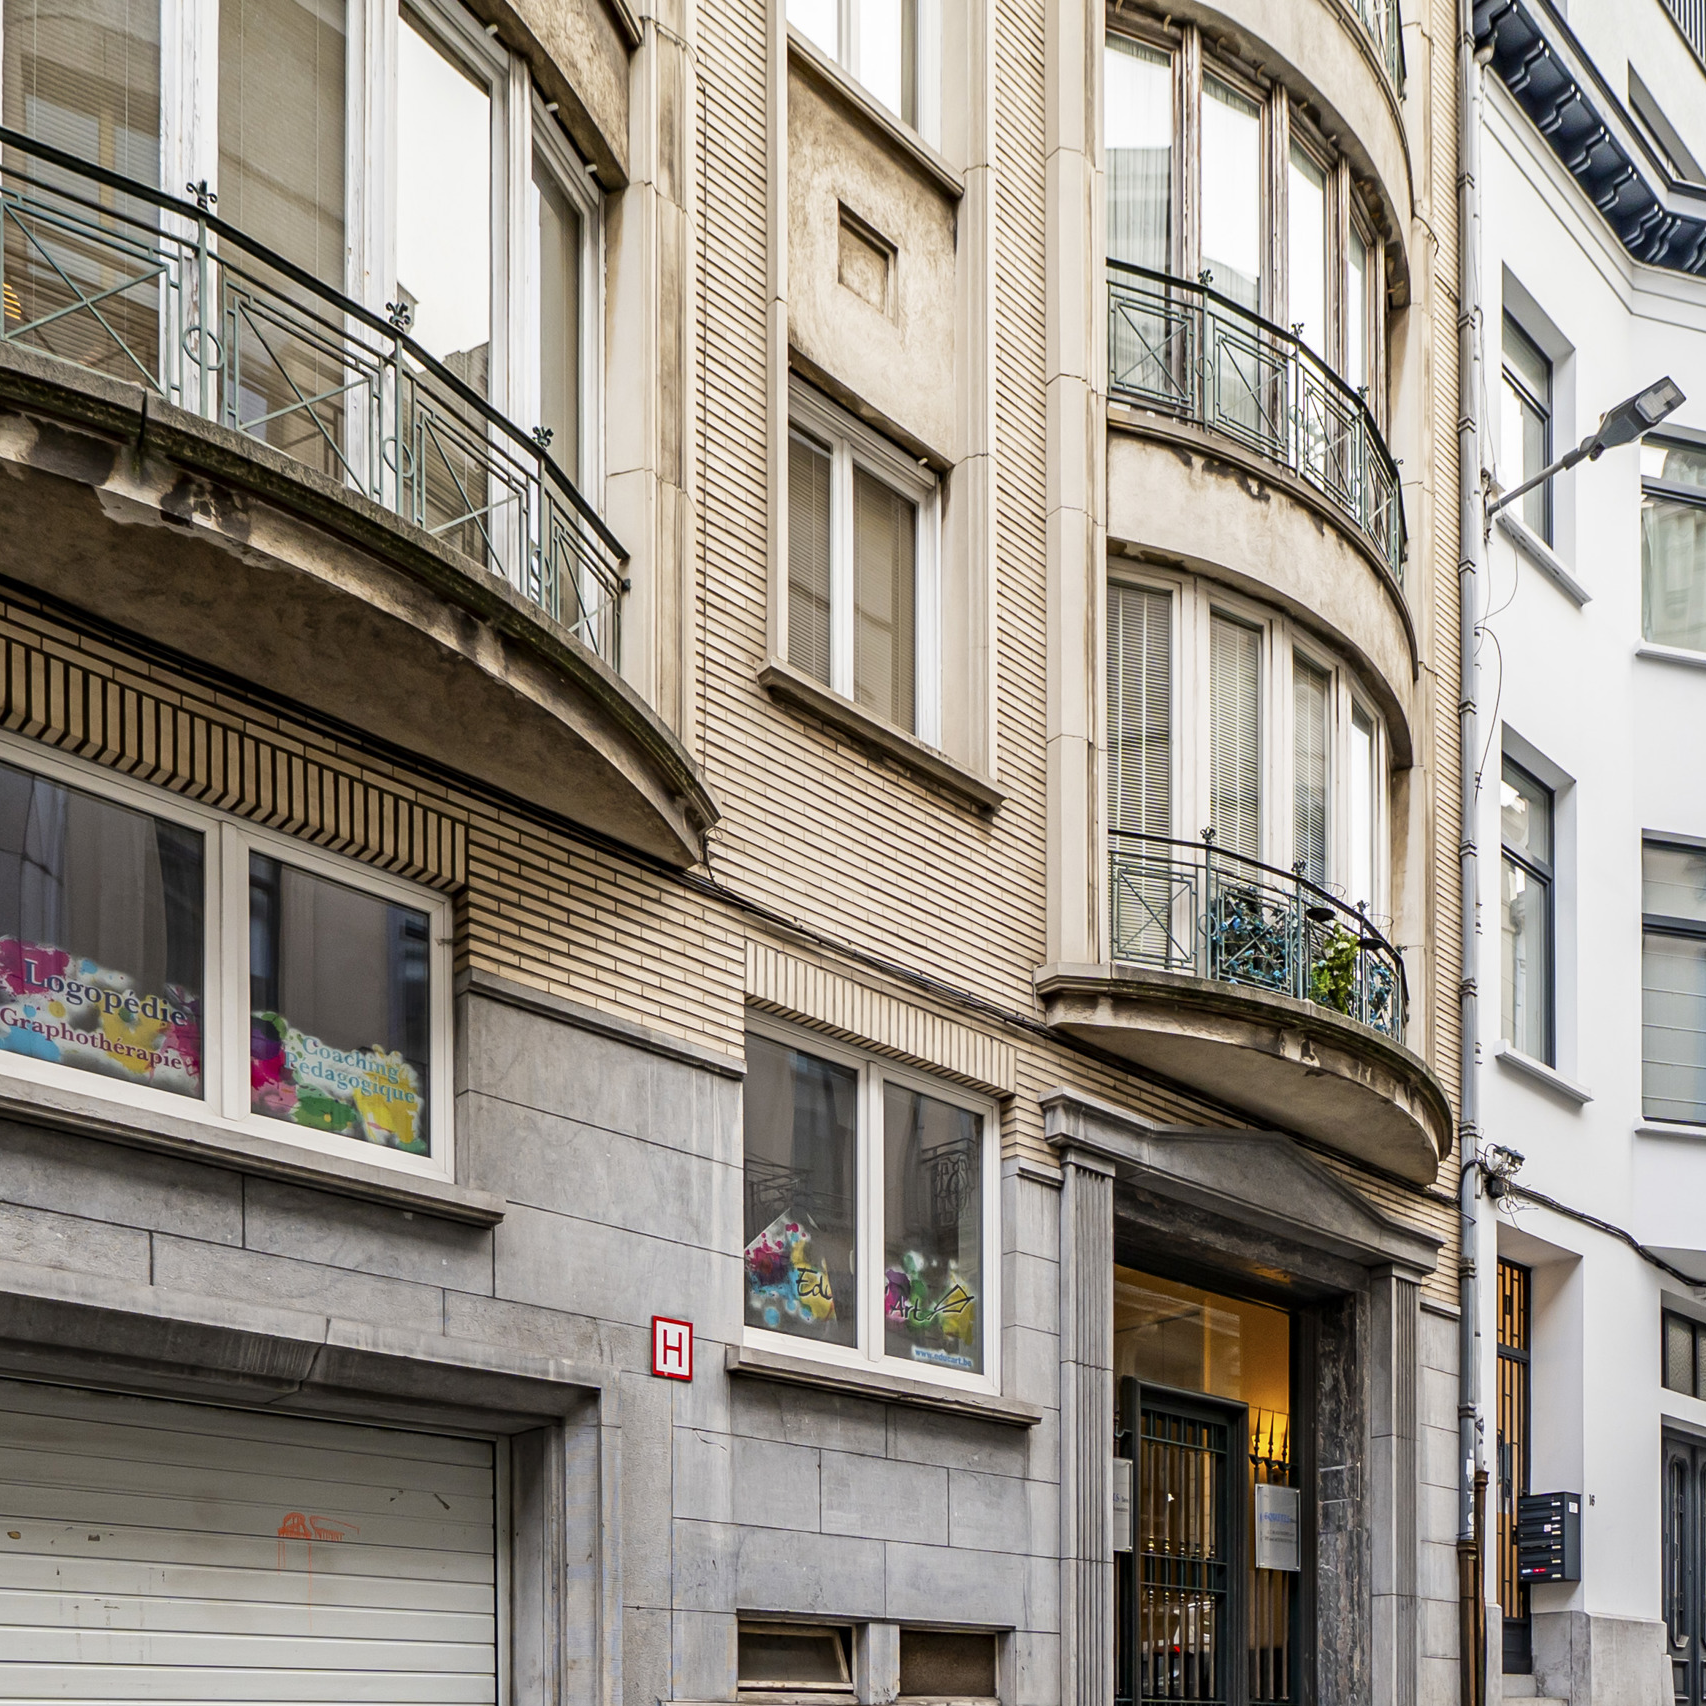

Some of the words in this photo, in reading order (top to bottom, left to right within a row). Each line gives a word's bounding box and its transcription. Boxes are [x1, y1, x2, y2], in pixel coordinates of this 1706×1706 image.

[24, 958, 187, 1026] Logopédie
[0, 1007, 182, 1069] Graphothérapie
[303, 1037, 399, 1084] Coaching
[284, 1051, 415, 1103] Pédagogique
[890, 1296, 925, 1321] Art
[663, 1329, 682, 1367] H
[914, 1349, 972, 1367] www.educart.be
